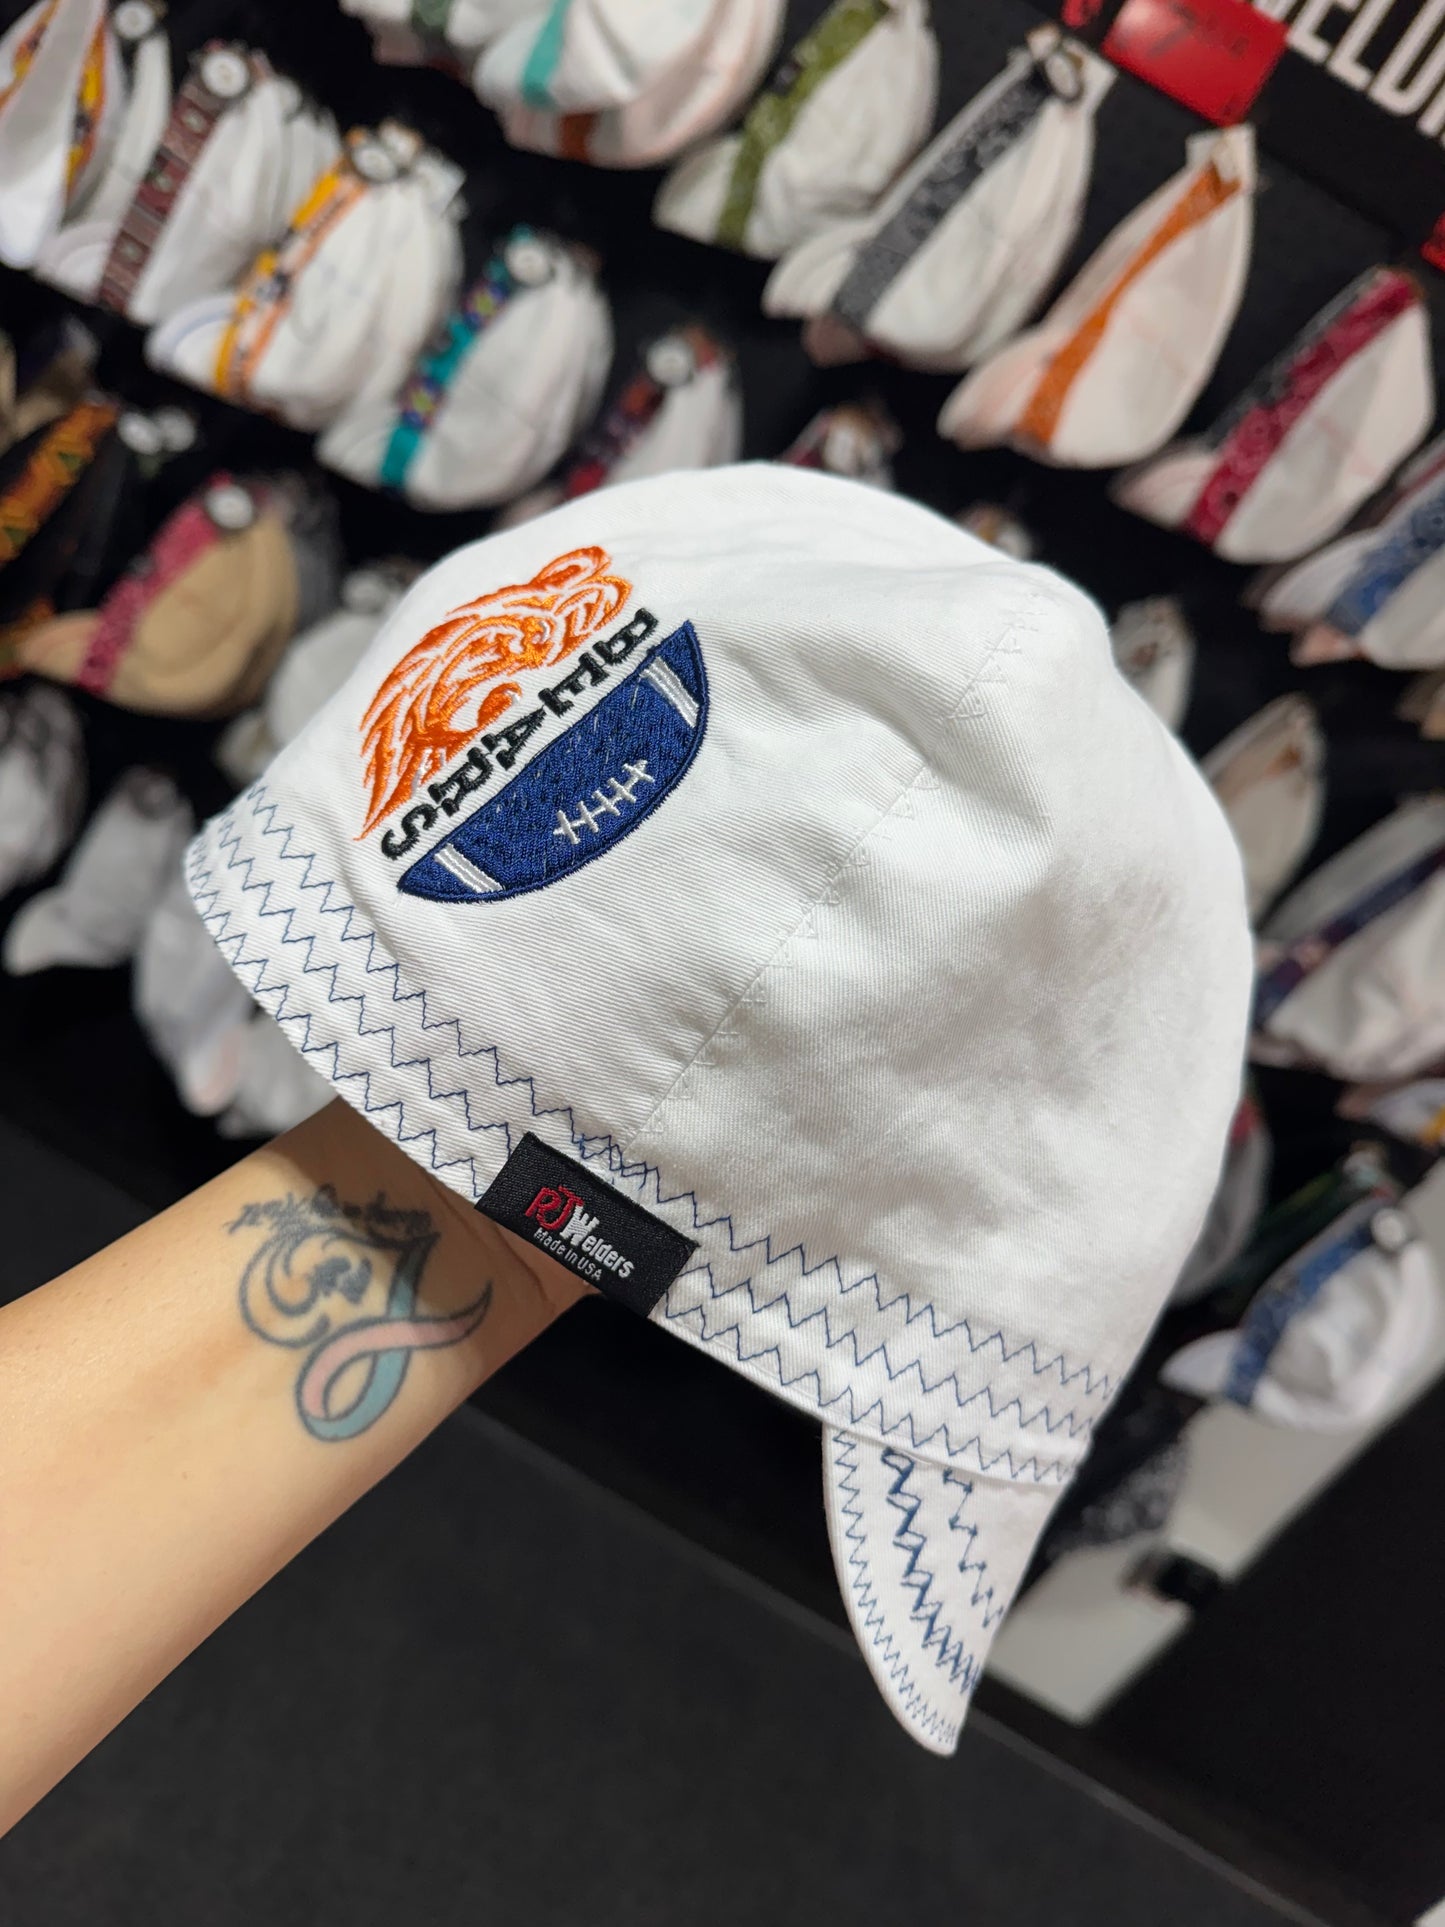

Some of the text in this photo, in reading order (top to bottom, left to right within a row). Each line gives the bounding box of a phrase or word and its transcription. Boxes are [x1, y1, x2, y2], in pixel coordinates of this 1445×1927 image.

[381, 608, 659, 861] BEARS
[533, 1227, 567, 1256] Made
[577, 1257, 603, 1281] USA
